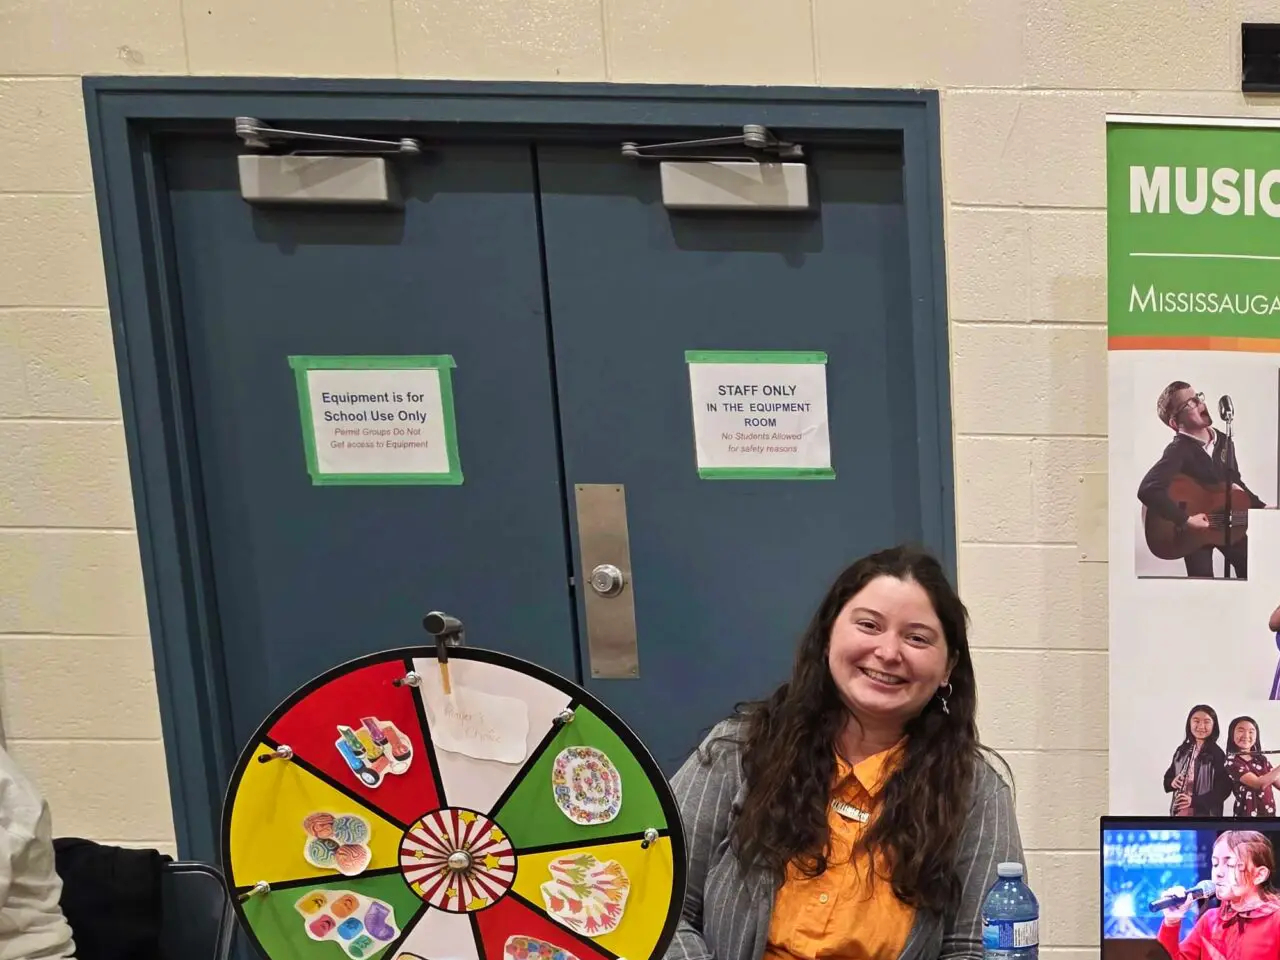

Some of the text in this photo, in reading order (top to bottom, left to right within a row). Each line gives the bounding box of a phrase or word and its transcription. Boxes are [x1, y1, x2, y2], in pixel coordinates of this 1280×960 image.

[718, 385, 797, 396] STAFF ONLY
[322, 392, 425, 405] Equipment is for
[707, 403, 811, 412] IN THE EQUIPMENT
[324, 410, 427, 424] School Use Only
[744, 418, 777, 427] ROOM
[334, 428, 421, 437] Permit Groups Do Not
[721, 432, 802, 441] No Students Allowed
[330, 440, 428, 450] Get access to Equipment
[728, 444, 739, 452] for
[741, 444, 764, 454] safety
